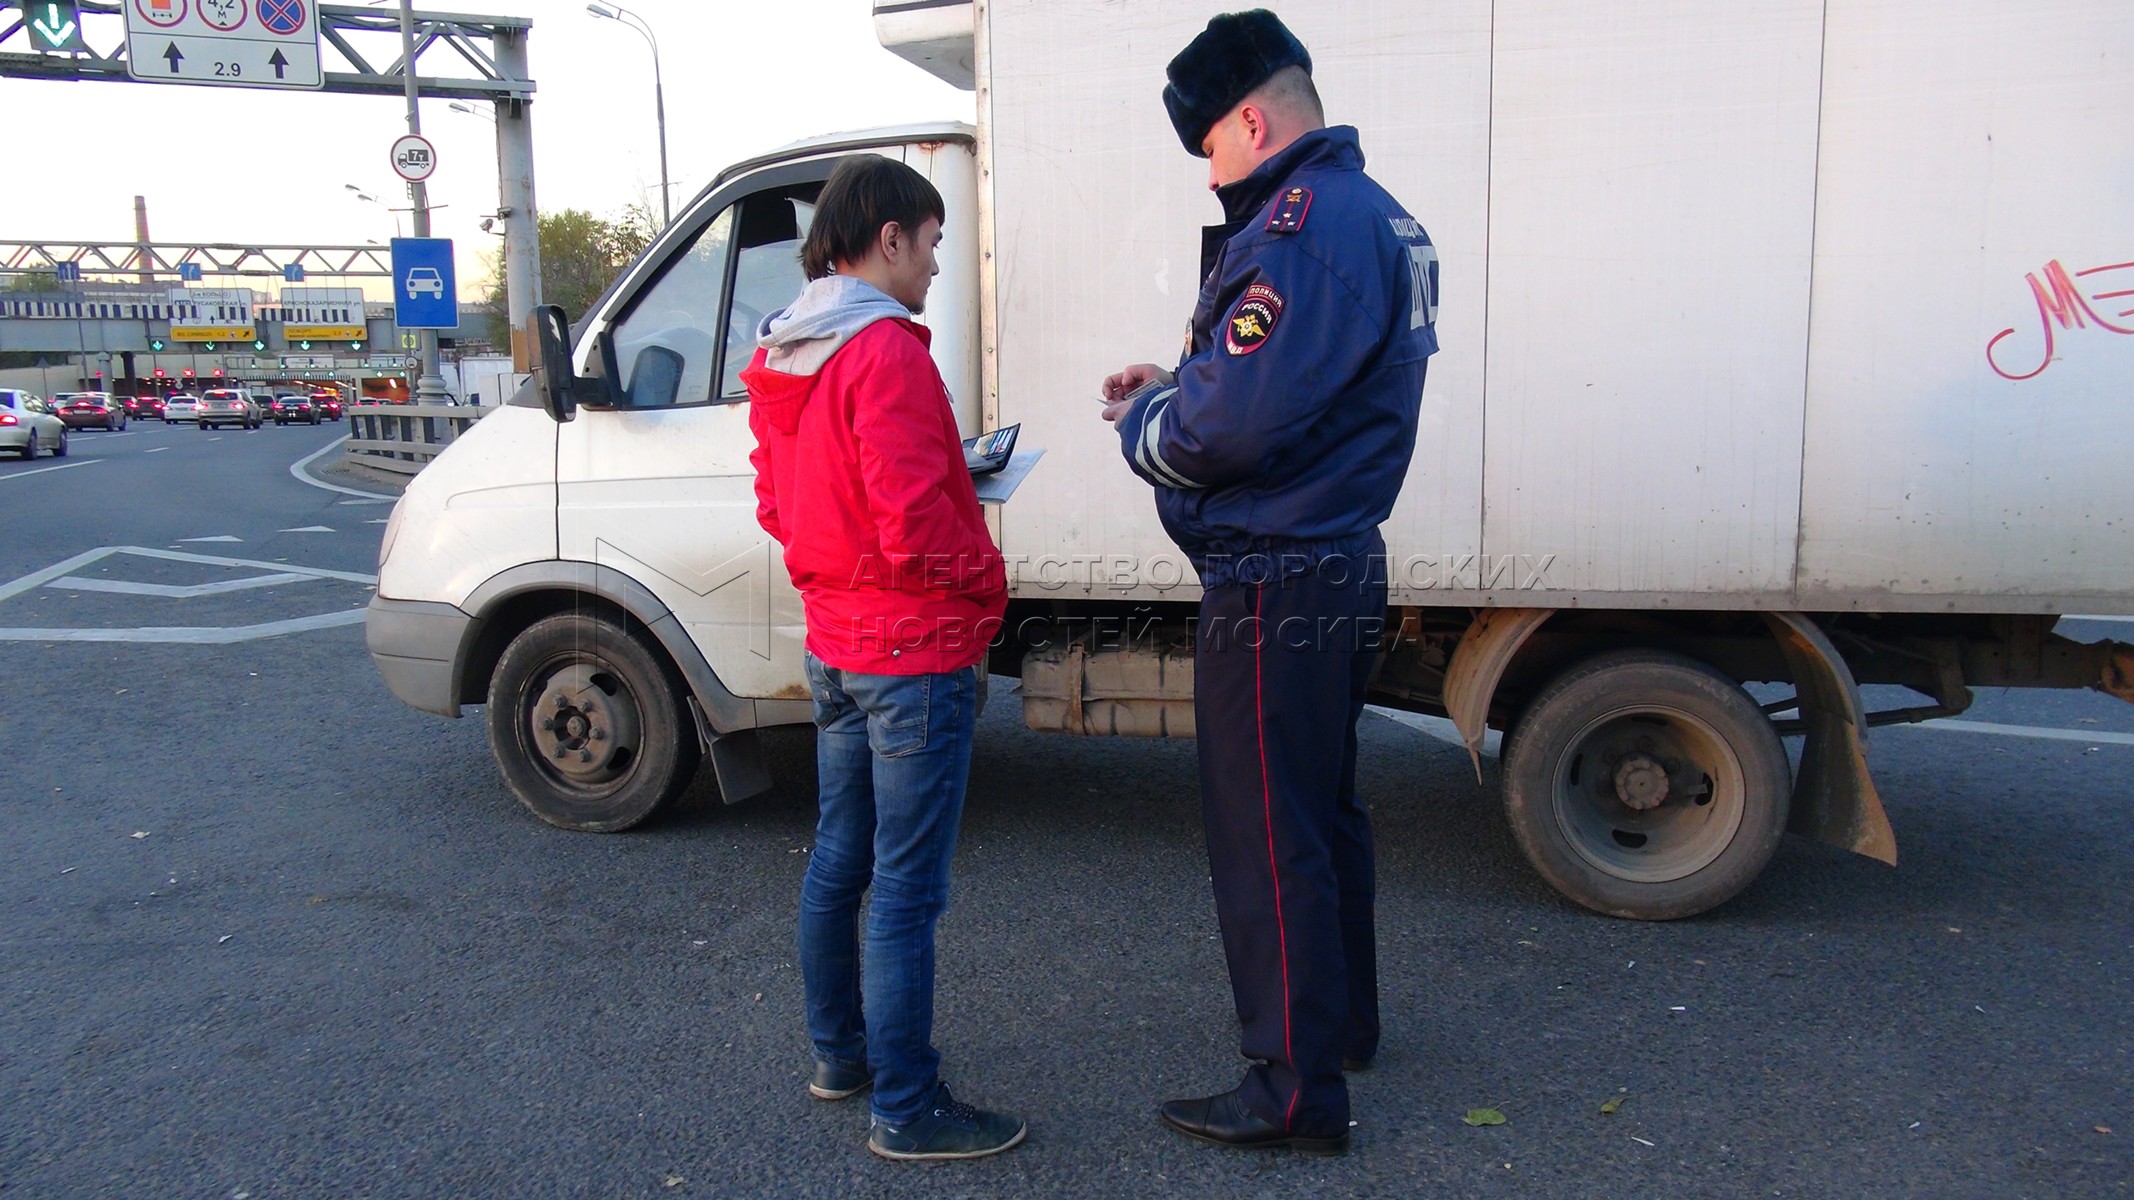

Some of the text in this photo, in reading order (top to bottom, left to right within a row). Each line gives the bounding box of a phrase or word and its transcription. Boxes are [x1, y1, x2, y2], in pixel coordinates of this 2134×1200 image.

[214, 61, 241, 77] 2.9
[1249, 287, 1283, 308] ПОЛИЦИЯ
[1241, 302, 1273, 324] РОССИЯ
[1227, 341, 1244, 355] МВД
